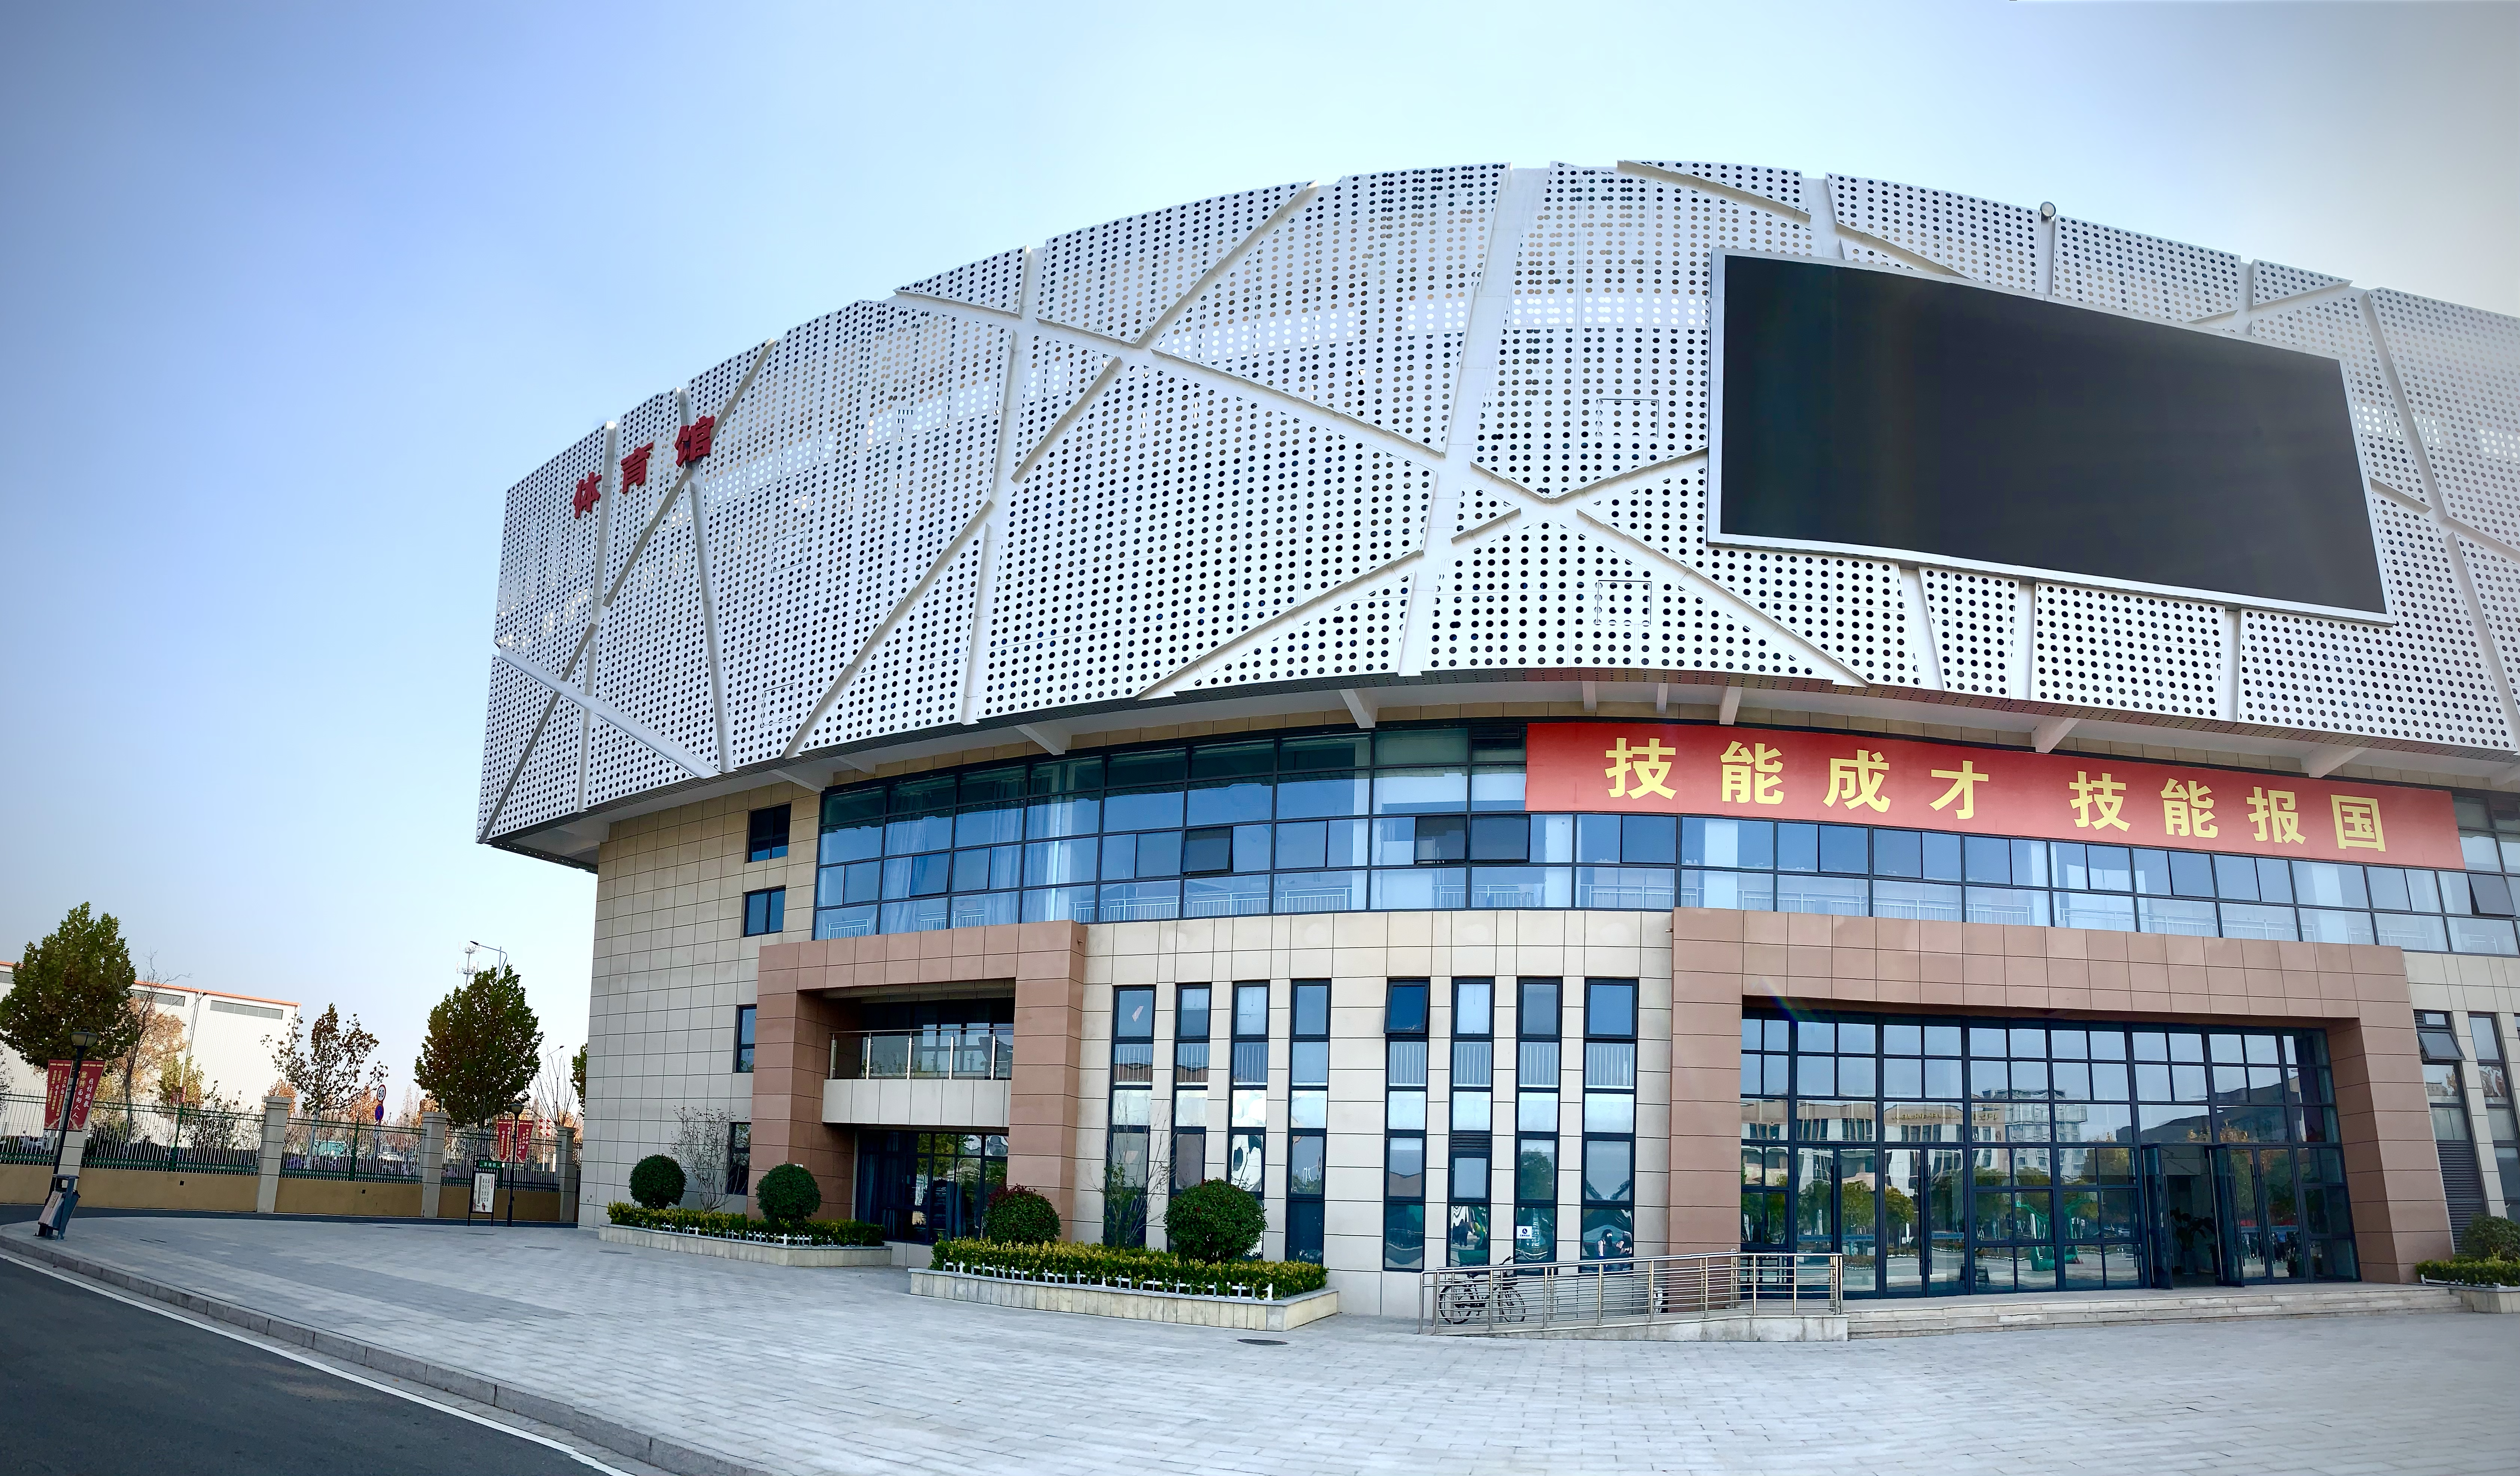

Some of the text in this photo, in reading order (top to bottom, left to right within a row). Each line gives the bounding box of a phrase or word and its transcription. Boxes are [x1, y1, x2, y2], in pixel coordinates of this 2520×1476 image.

[572, 415, 715, 519] 体育馆
[1604, 737, 2387, 852] 技能成才 技能报国
